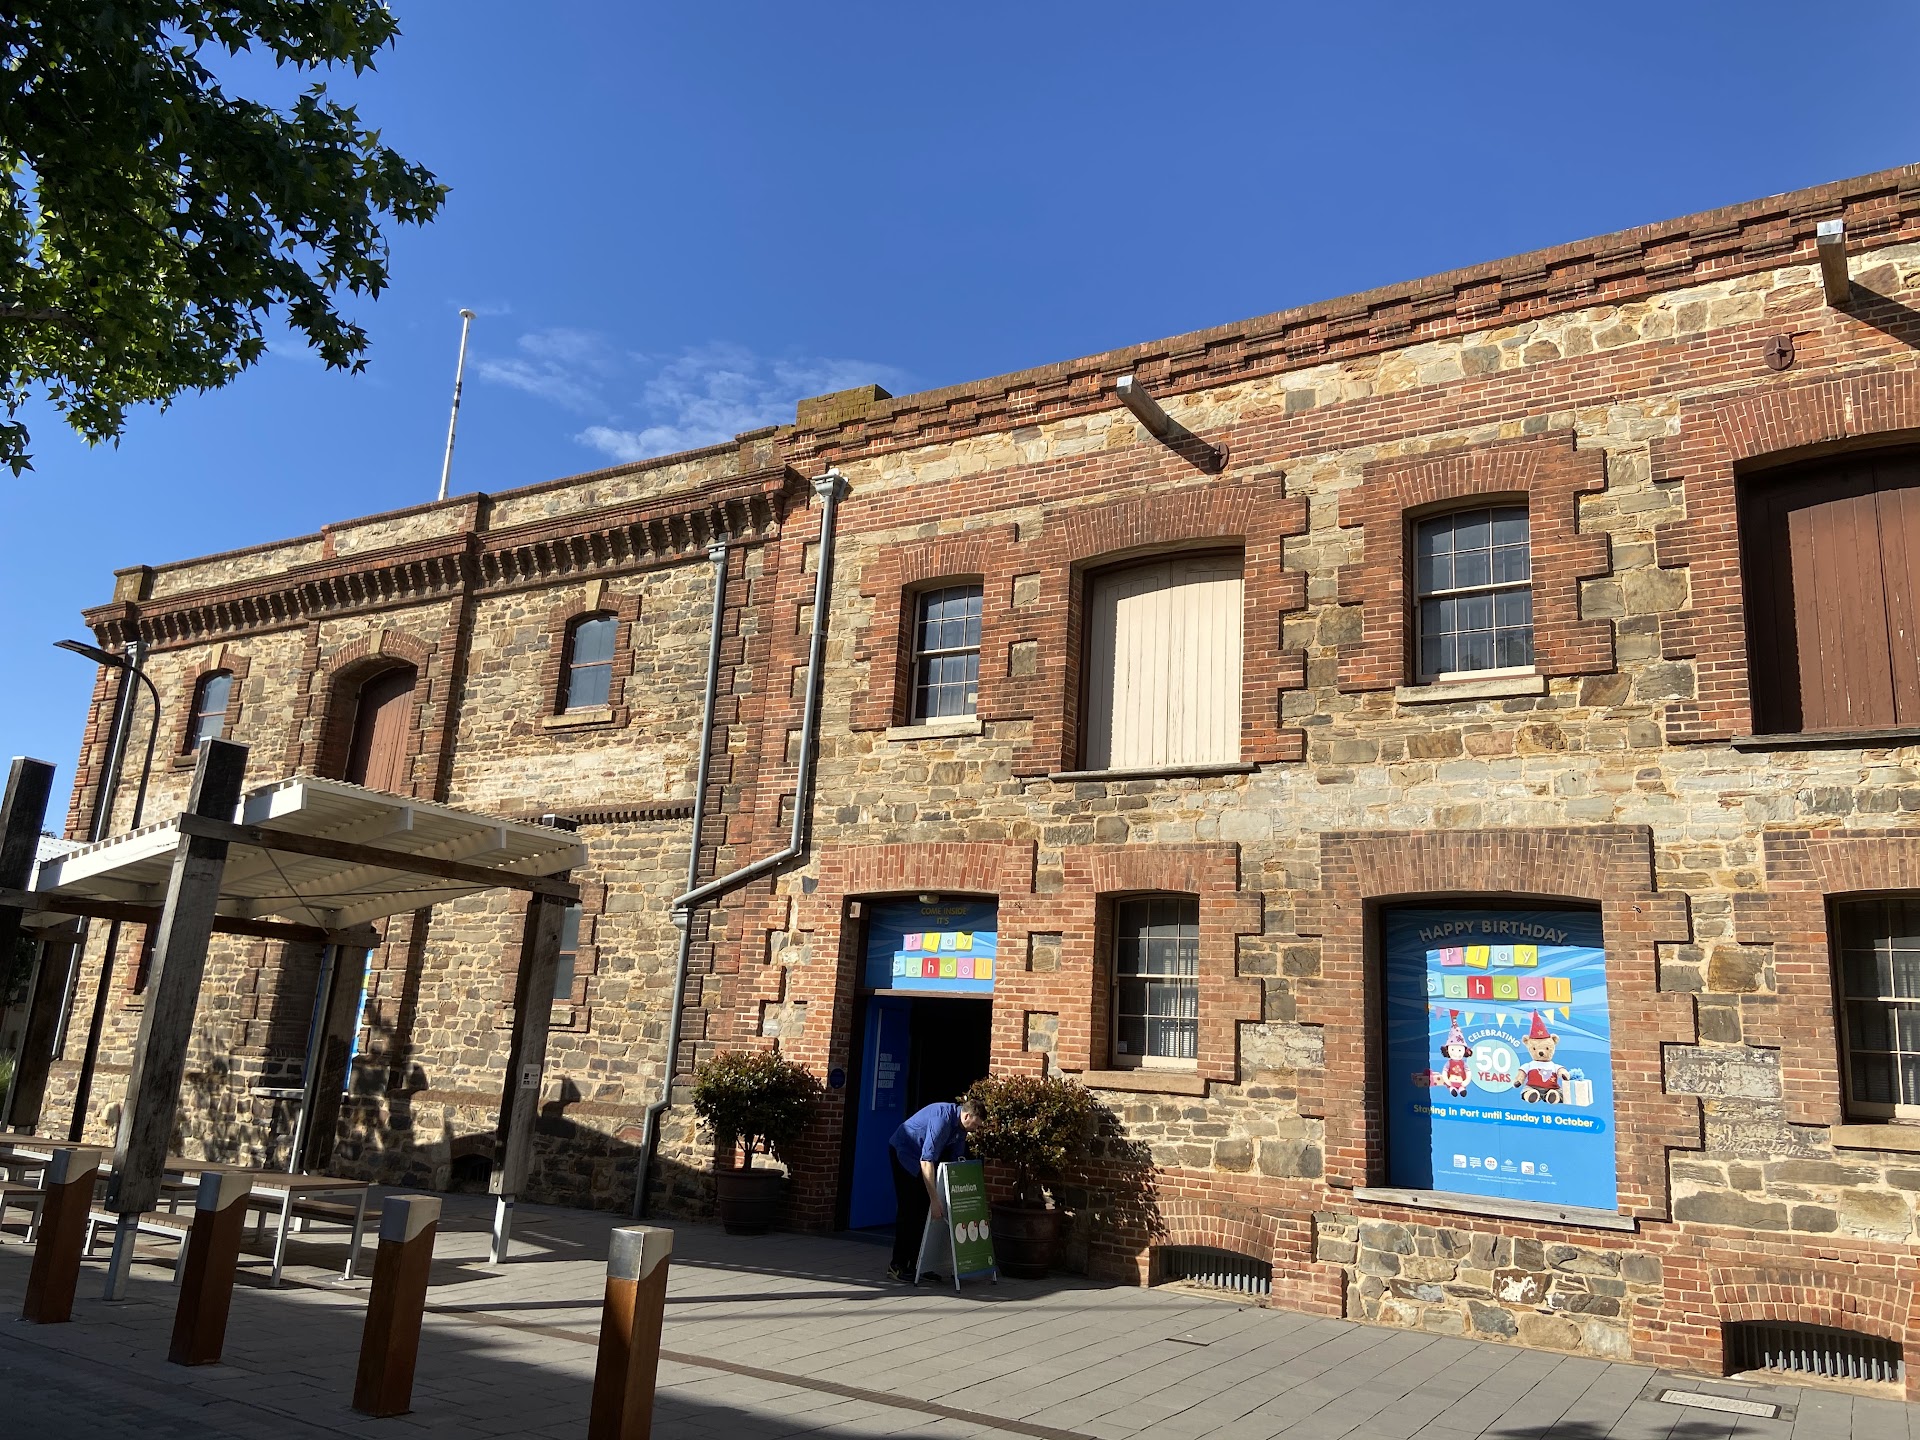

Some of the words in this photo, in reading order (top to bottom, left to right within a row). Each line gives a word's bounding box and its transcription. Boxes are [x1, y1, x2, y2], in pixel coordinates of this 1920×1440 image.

[921, 907, 941, 915] COME
[943, 906, 967, 915] INSIDE
[1419, 920, 1474, 942] HAPPY
[1482, 920, 1568, 944] BIRTHDAY
[909, 935, 968, 947] Play
[1444, 947, 1534, 963] Play
[893, 959, 987, 975] School
[1426, 977, 1562, 997] School
[1468, 1028, 1521, 1049] CELEBRATING
[1475, 1046, 1511, 1071] 50
[1477, 1072, 1511, 1084] YEARS
[1413, 1104, 1446, 1117] Staying
[1459, 1108, 1480, 1118] Port
[1481, 1110, 1503, 1120] until
[1504, 1111, 1540, 1124] Sunday
[1542, 1114, 1553, 1124] 18
[1554, 1115, 1594, 1128] October
[951, 1184, 977, 1194] Attention
